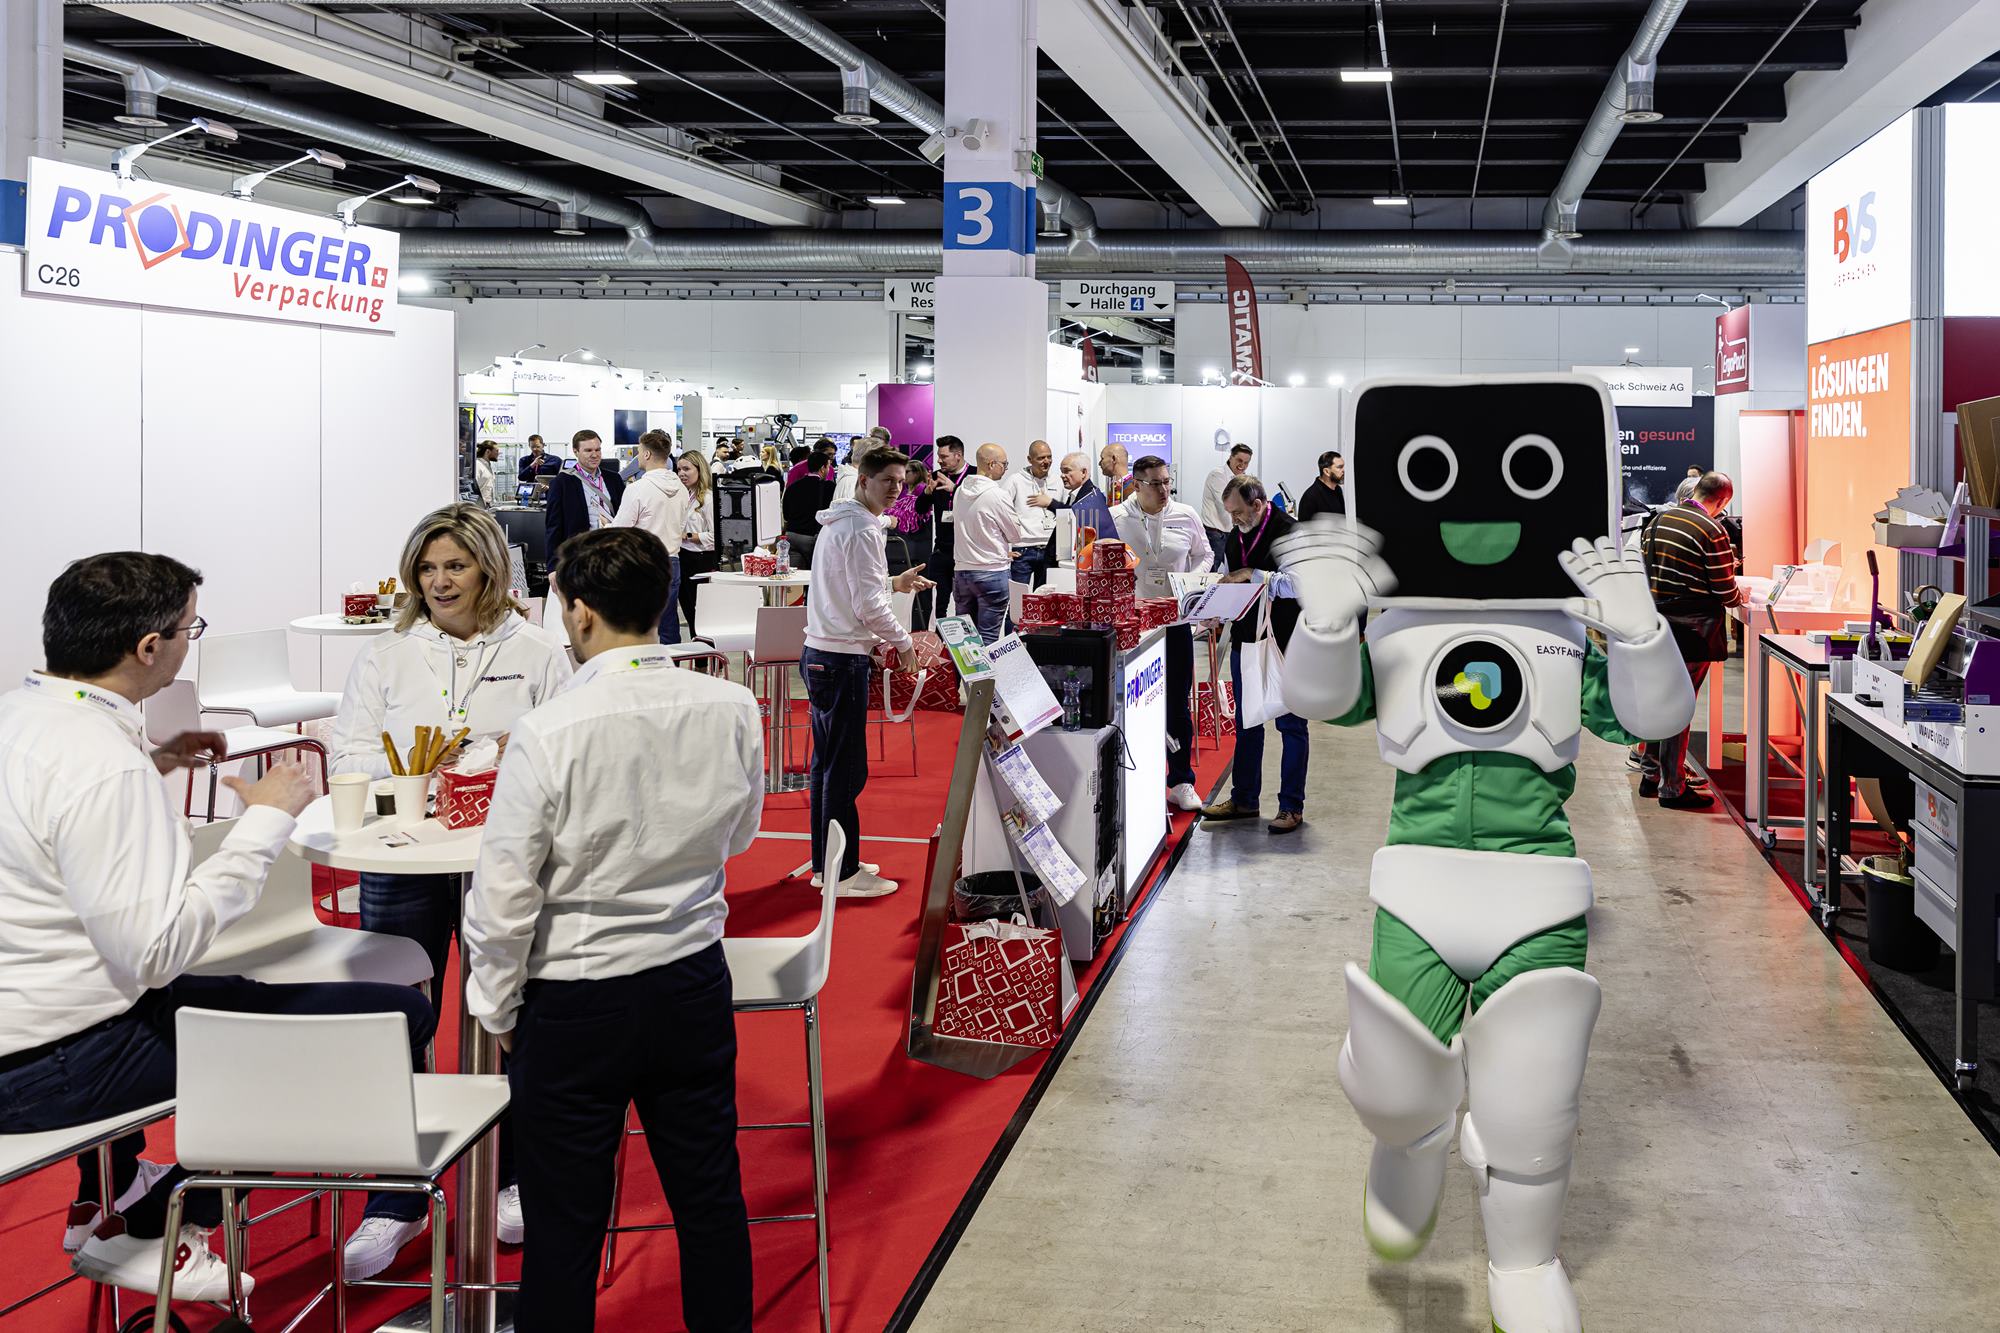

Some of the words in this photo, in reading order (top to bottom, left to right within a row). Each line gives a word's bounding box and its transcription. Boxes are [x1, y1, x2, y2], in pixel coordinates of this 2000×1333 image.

[956, 186, 994, 246] 3
[46, 185, 372, 286] PRODINGER
[38, 263, 81, 288] C26
[910, 281, 935, 294] WC
[1079, 282, 1156, 298] Durchgang
[232, 271, 384, 323] Verpackung
[911, 296, 936, 308] Res
[1090, 297, 1126, 310] Halle
[1132, 297, 1143, 311] 4
[533, 372, 548, 382] Pack
[1810, 352, 1890, 401] LÖSUNGEN
[1627, 382, 1667, 392] Schweiz
[1669, 382, 1685, 392] AG
[492, 415, 514, 425] EXXTRA
[1810, 400, 1868, 438] FINDEN.
[1617, 430, 1635, 441] en
[1638, 427, 1696, 444] gesund
[1643, 464, 1667, 472] effiziente
[1536, 645, 1585, 661] EASYFAIRS
[480, 673, 522, 682] PRODINGER
[1126, 656, 1162, 709] PRODINGER
